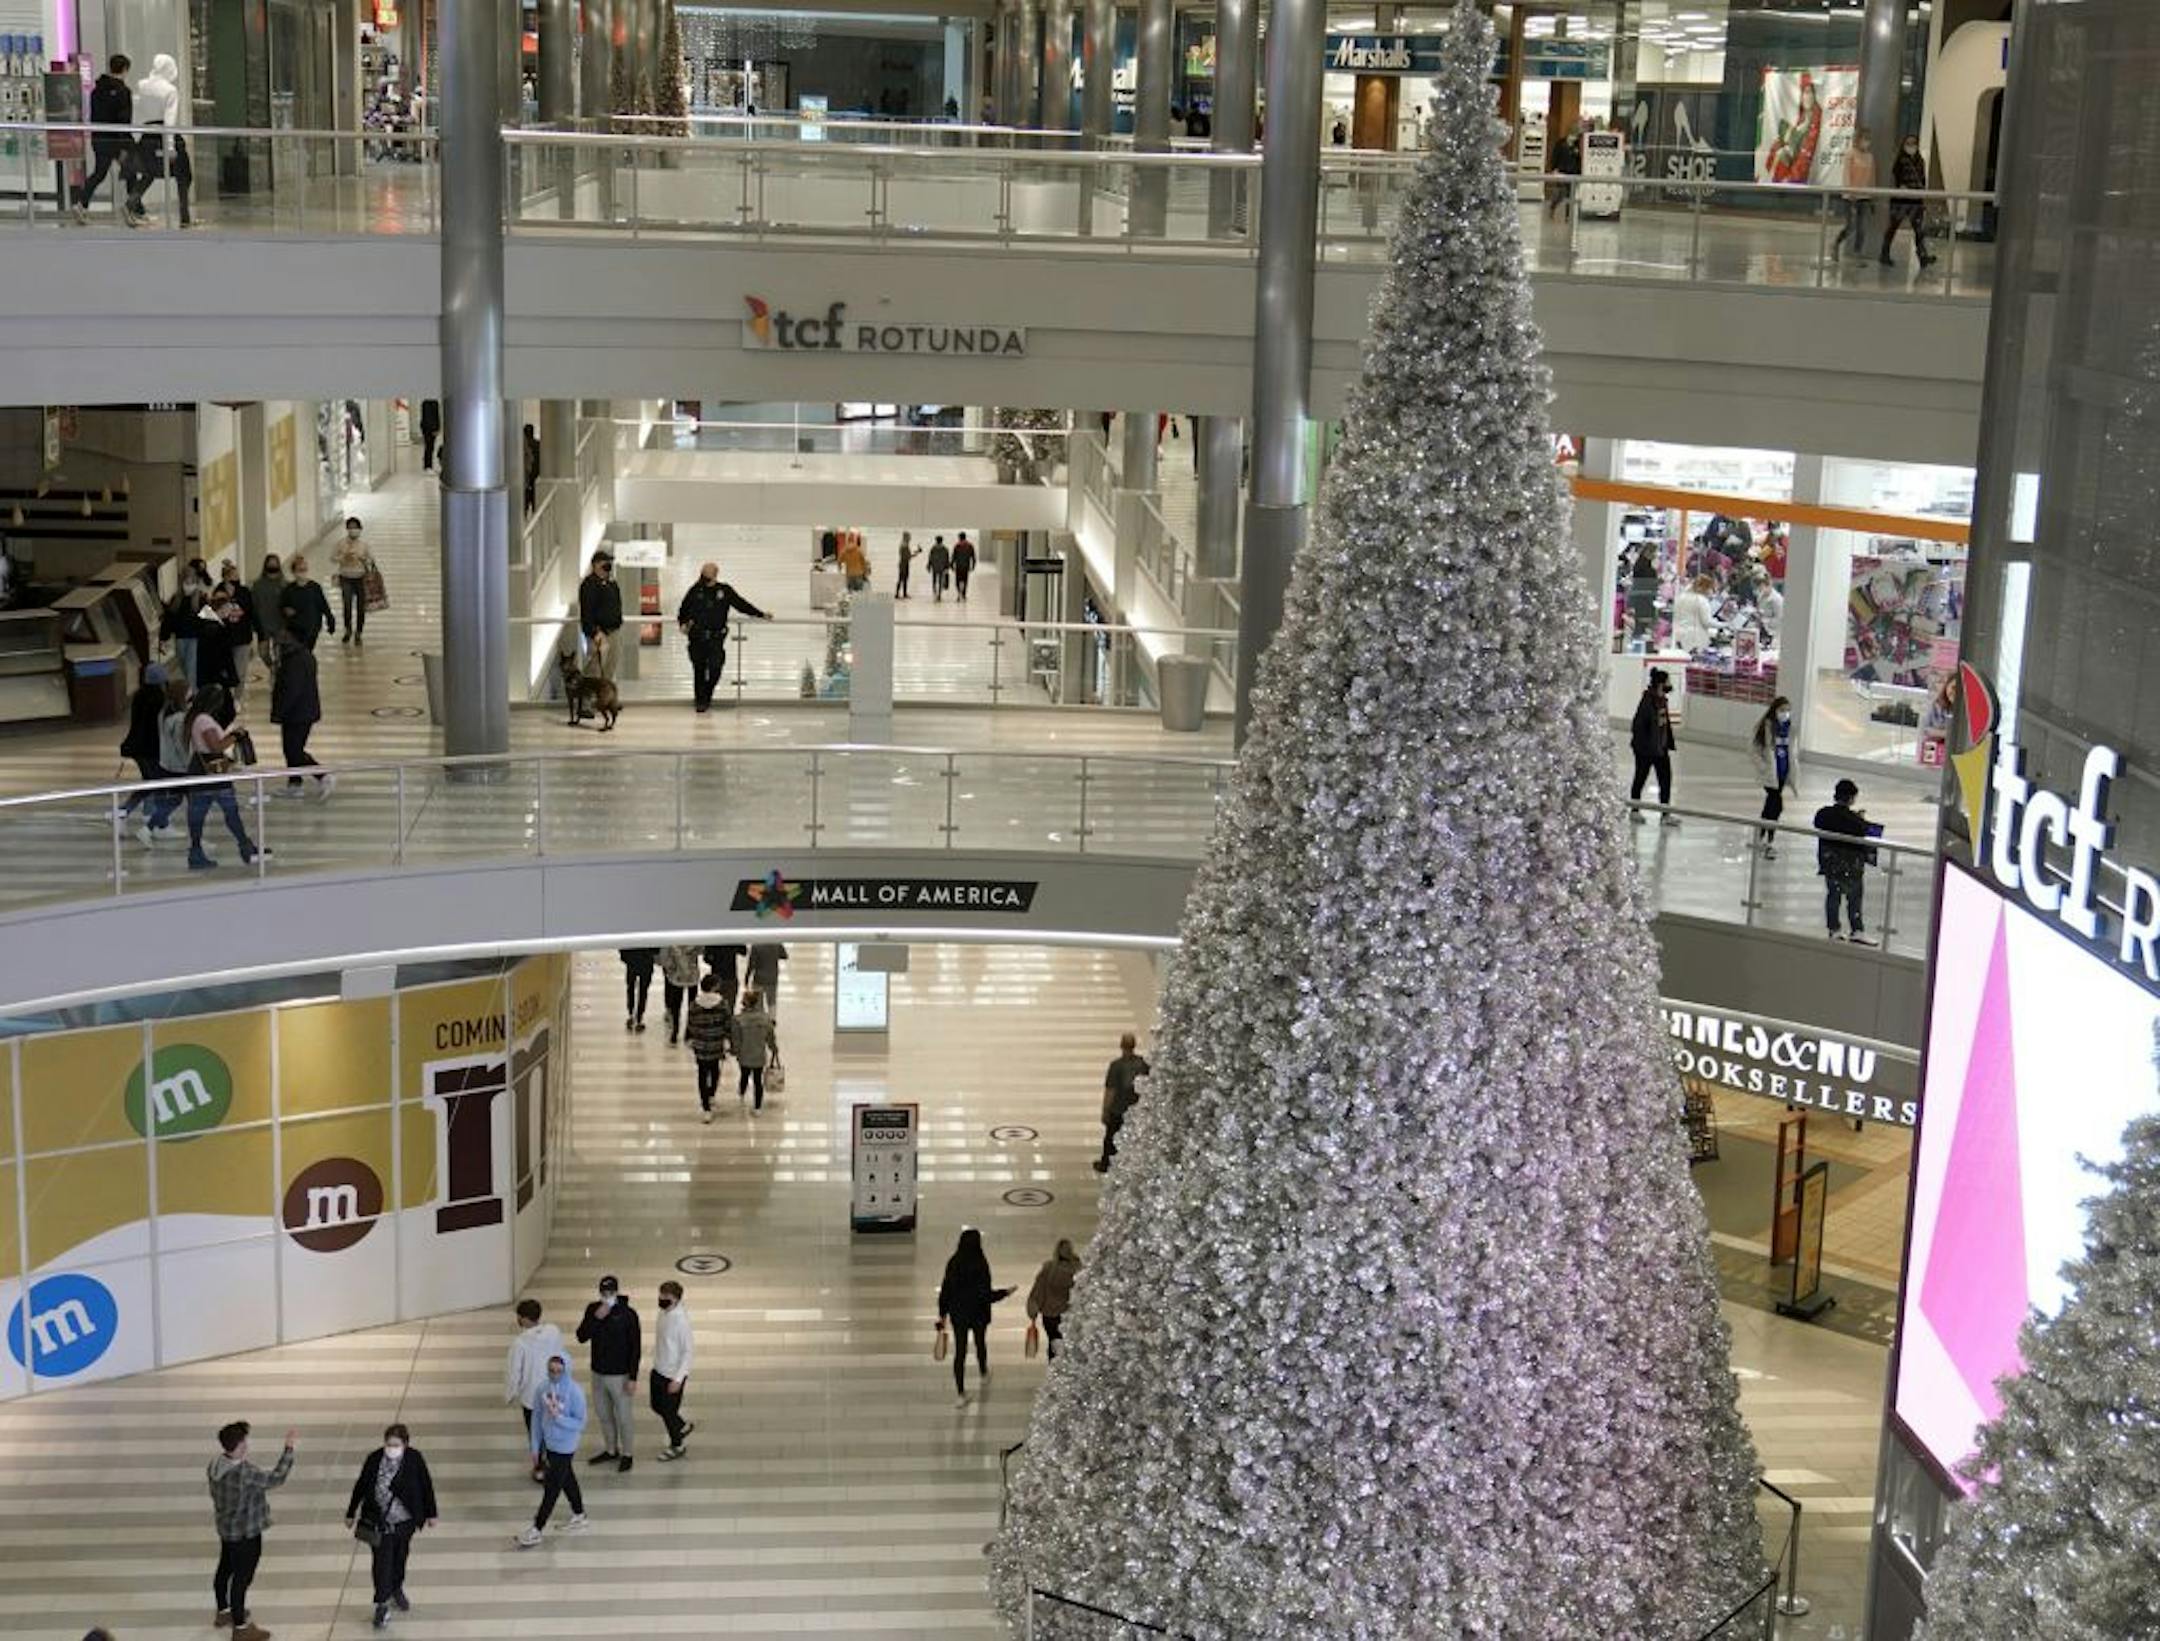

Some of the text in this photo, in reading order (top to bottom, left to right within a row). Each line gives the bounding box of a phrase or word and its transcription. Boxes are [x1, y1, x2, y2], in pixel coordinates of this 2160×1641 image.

[1333, 38, 1411, 68] Marshalls
[1667, 155, 1717, 183] SHOE
[774, 301, 1024, 354] tcf ROTUNDA
[1992, 742, 2118, 940] tcf
[811, 885, 1021, 906] MALL OF AMERICA
[151, 1068, 213, 1123] m
[305, 1183, 361, 1226] m
[32, 1298, 96, 1356] m
